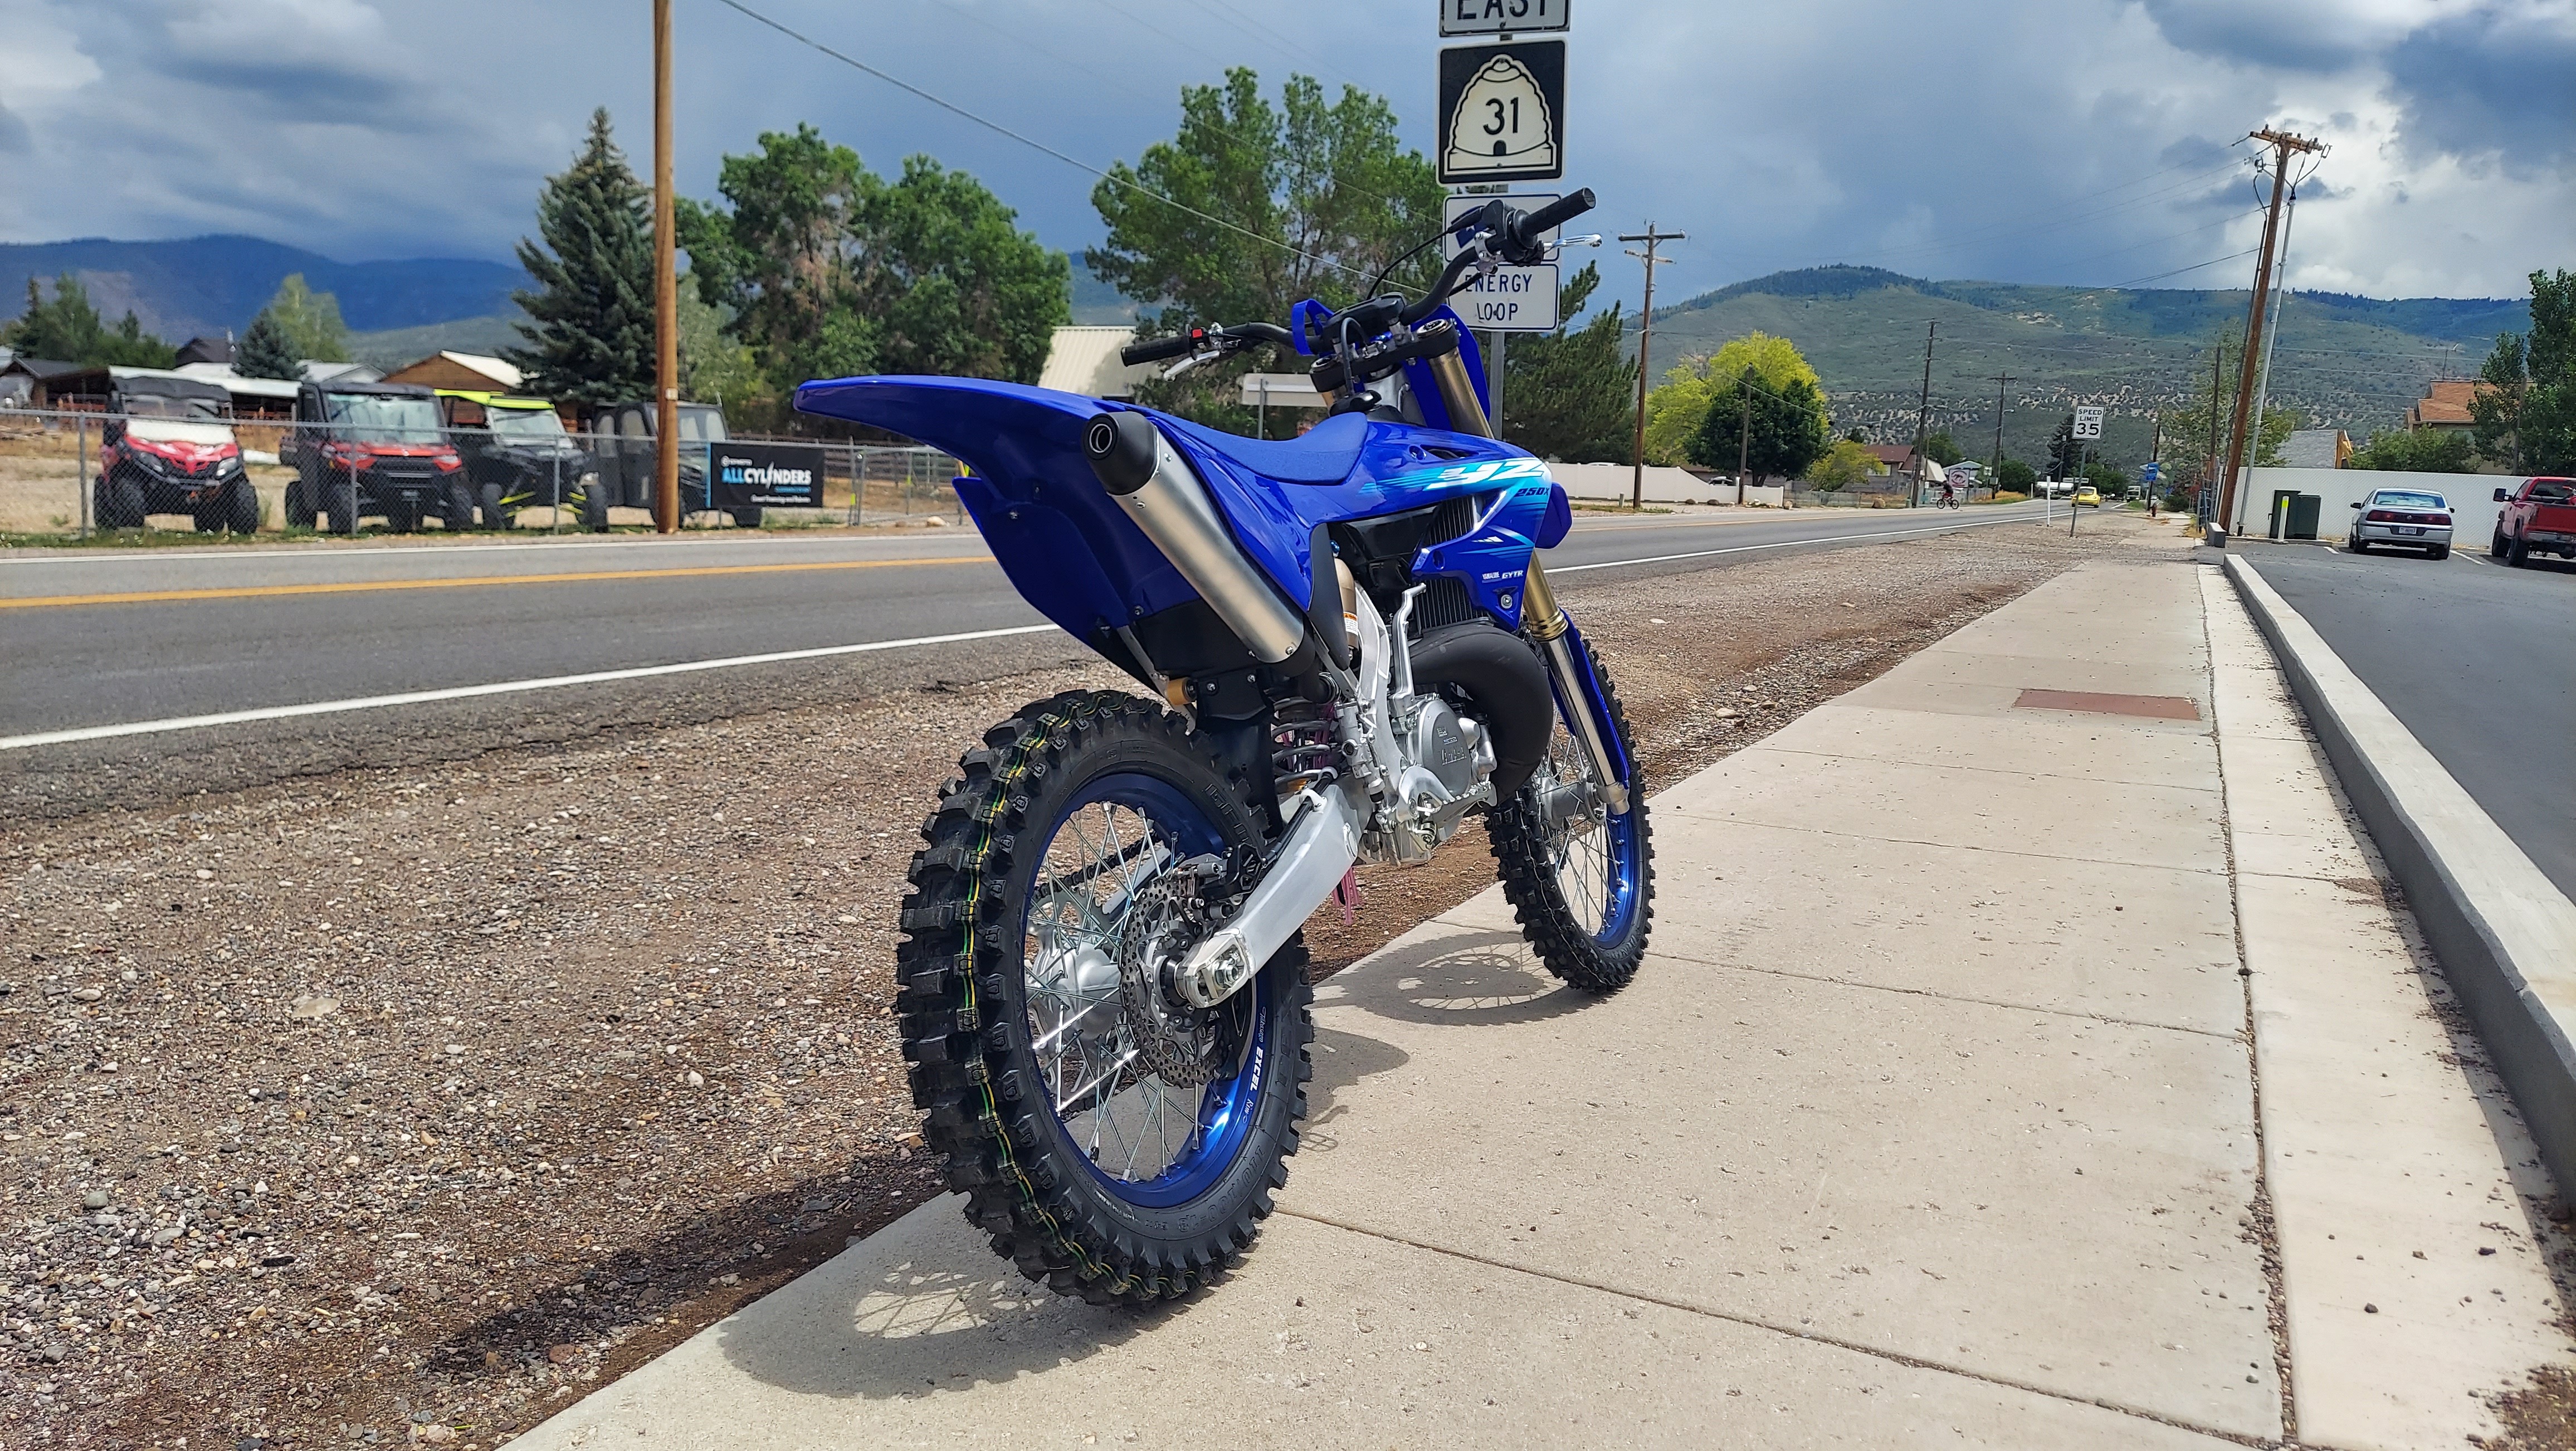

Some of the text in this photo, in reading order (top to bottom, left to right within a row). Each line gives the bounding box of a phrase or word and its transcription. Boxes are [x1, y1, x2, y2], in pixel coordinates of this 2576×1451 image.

[1483, 96, 1519, 135] 31
[1465, 274, 1532, 292] ENERGY
[1477, 303, 1518, 320] LOOP
[2076, 423, 2099, 436] 35
[1425, 460, 1545, 490] YZ
[1514, 487, 1550, 497] 250X
[1502, 570, 1524, 580] GYTR
[1250, 1046, 1263, 1092] EXCEL
